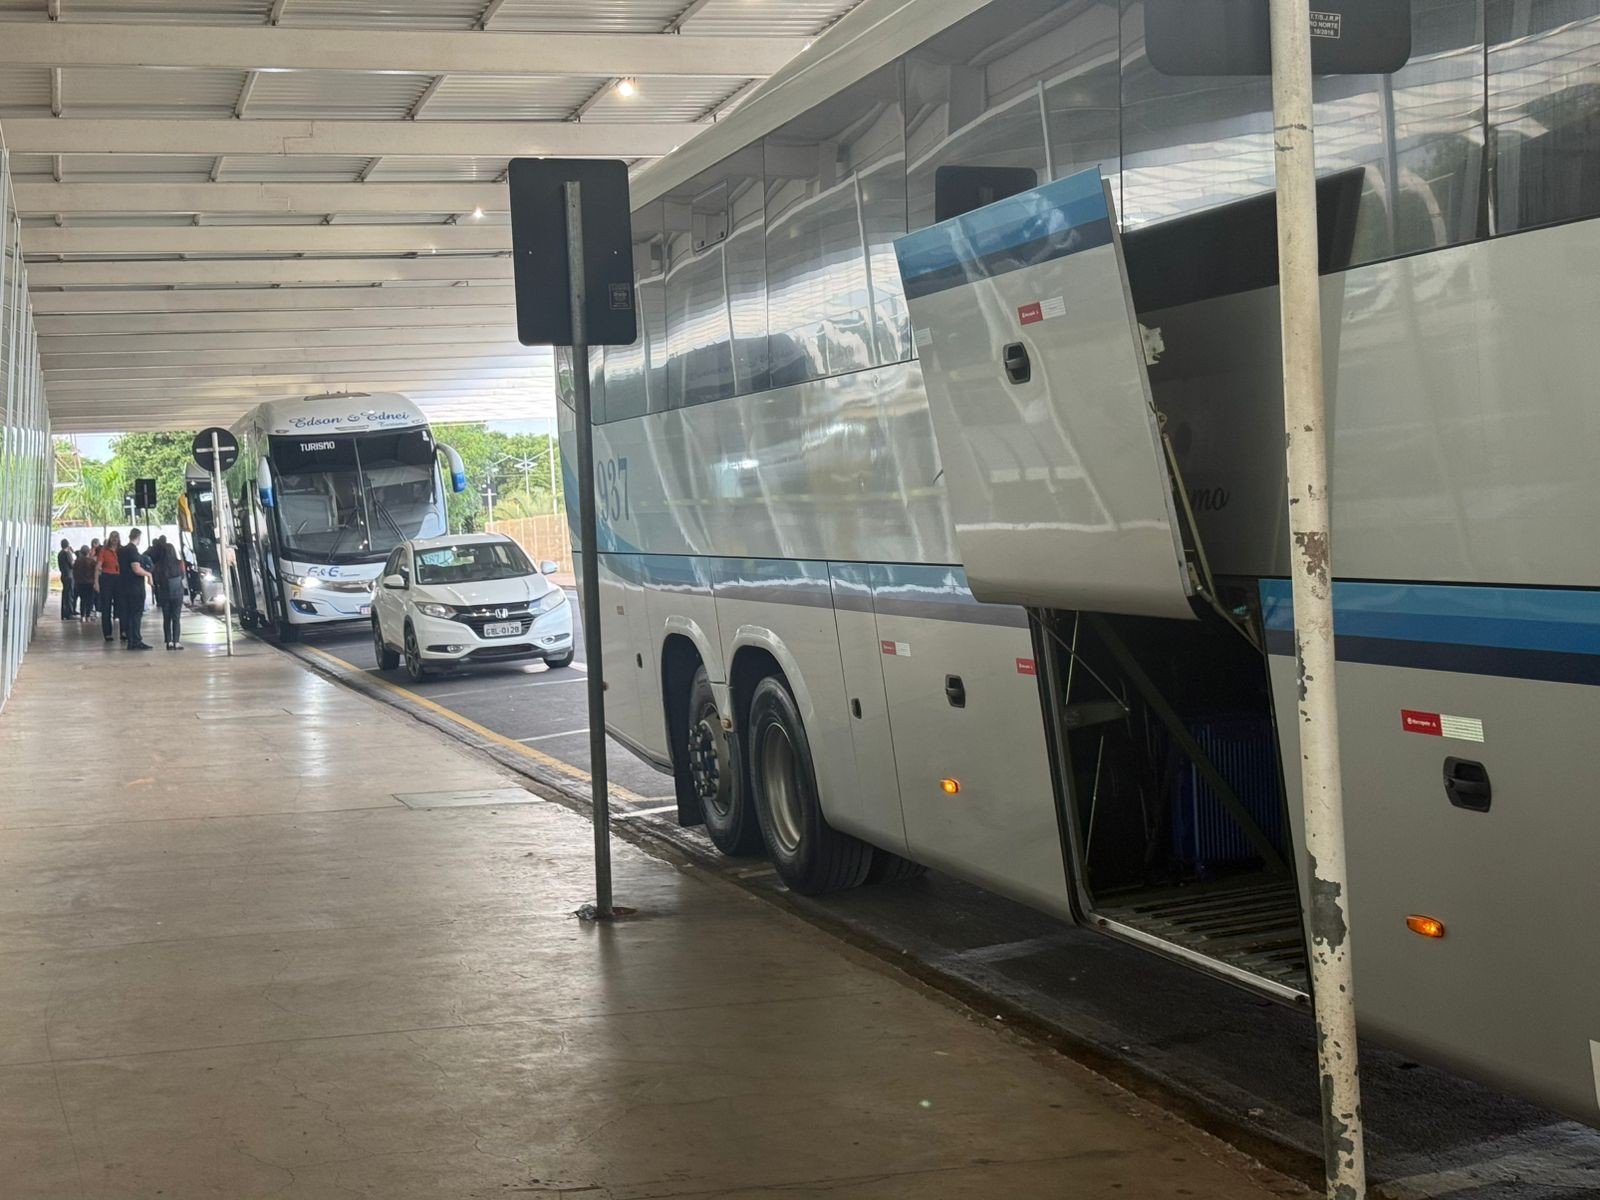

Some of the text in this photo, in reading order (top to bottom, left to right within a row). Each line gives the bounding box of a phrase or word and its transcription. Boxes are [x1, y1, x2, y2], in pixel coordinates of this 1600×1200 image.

[289, 415, 342, 428] Edson
[347, 413, 360, 422] &
[300, 441, 335, 452] TURISMO
[597, 457, 629, 521] 937
